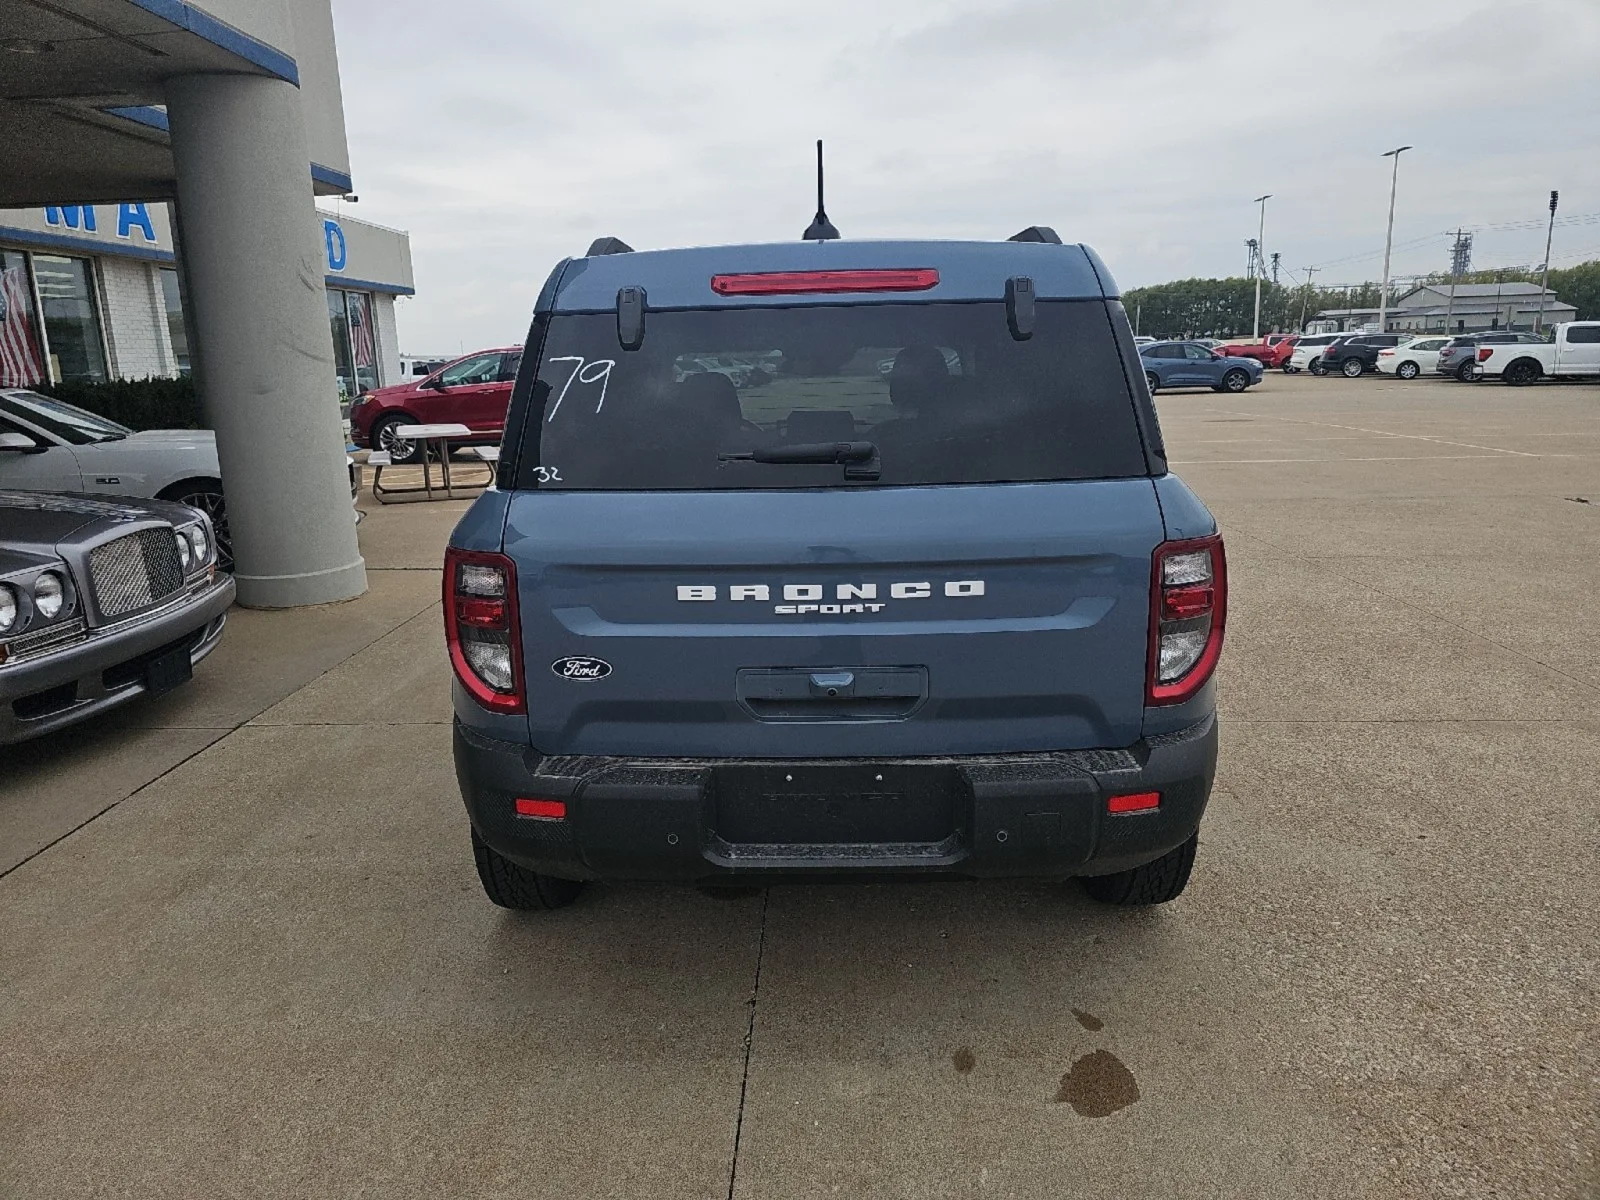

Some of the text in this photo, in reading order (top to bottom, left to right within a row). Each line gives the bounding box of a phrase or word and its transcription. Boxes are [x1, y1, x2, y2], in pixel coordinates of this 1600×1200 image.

[548, 356, 616, 422] 79
[533, 466, 563, 482] 32
[676, 580, 985, 601] BRONCO
[774, 603, 886, 614] SPORT
[563, 660, 601, 676] Ford
